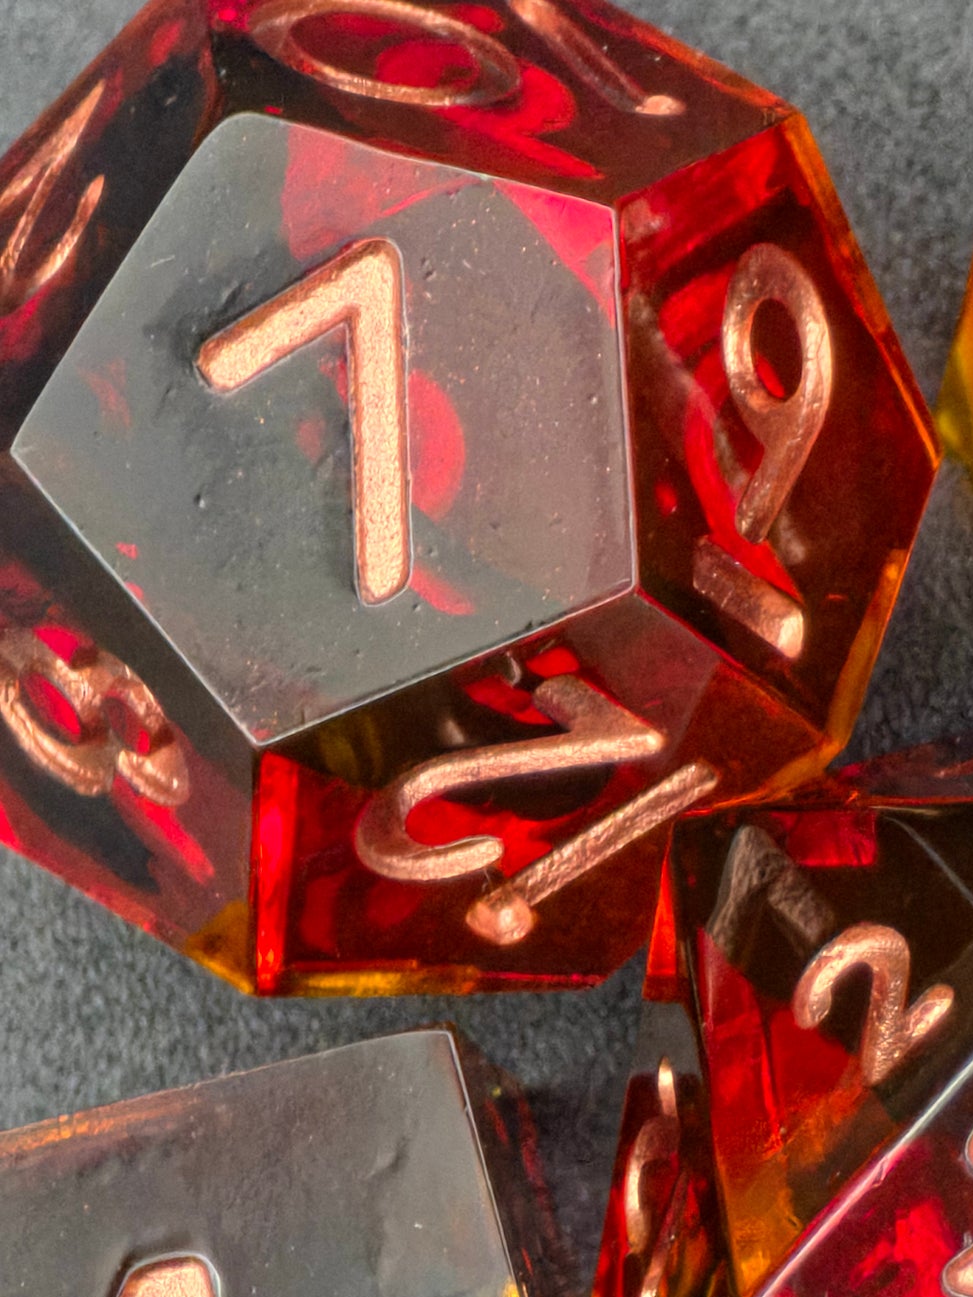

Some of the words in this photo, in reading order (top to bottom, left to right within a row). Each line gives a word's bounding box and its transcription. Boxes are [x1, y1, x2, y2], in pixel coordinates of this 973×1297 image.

[196, 237, 413, 607] 7
[355, 675, 719, 946] 12
[793, 922, 954, 1087] 2
